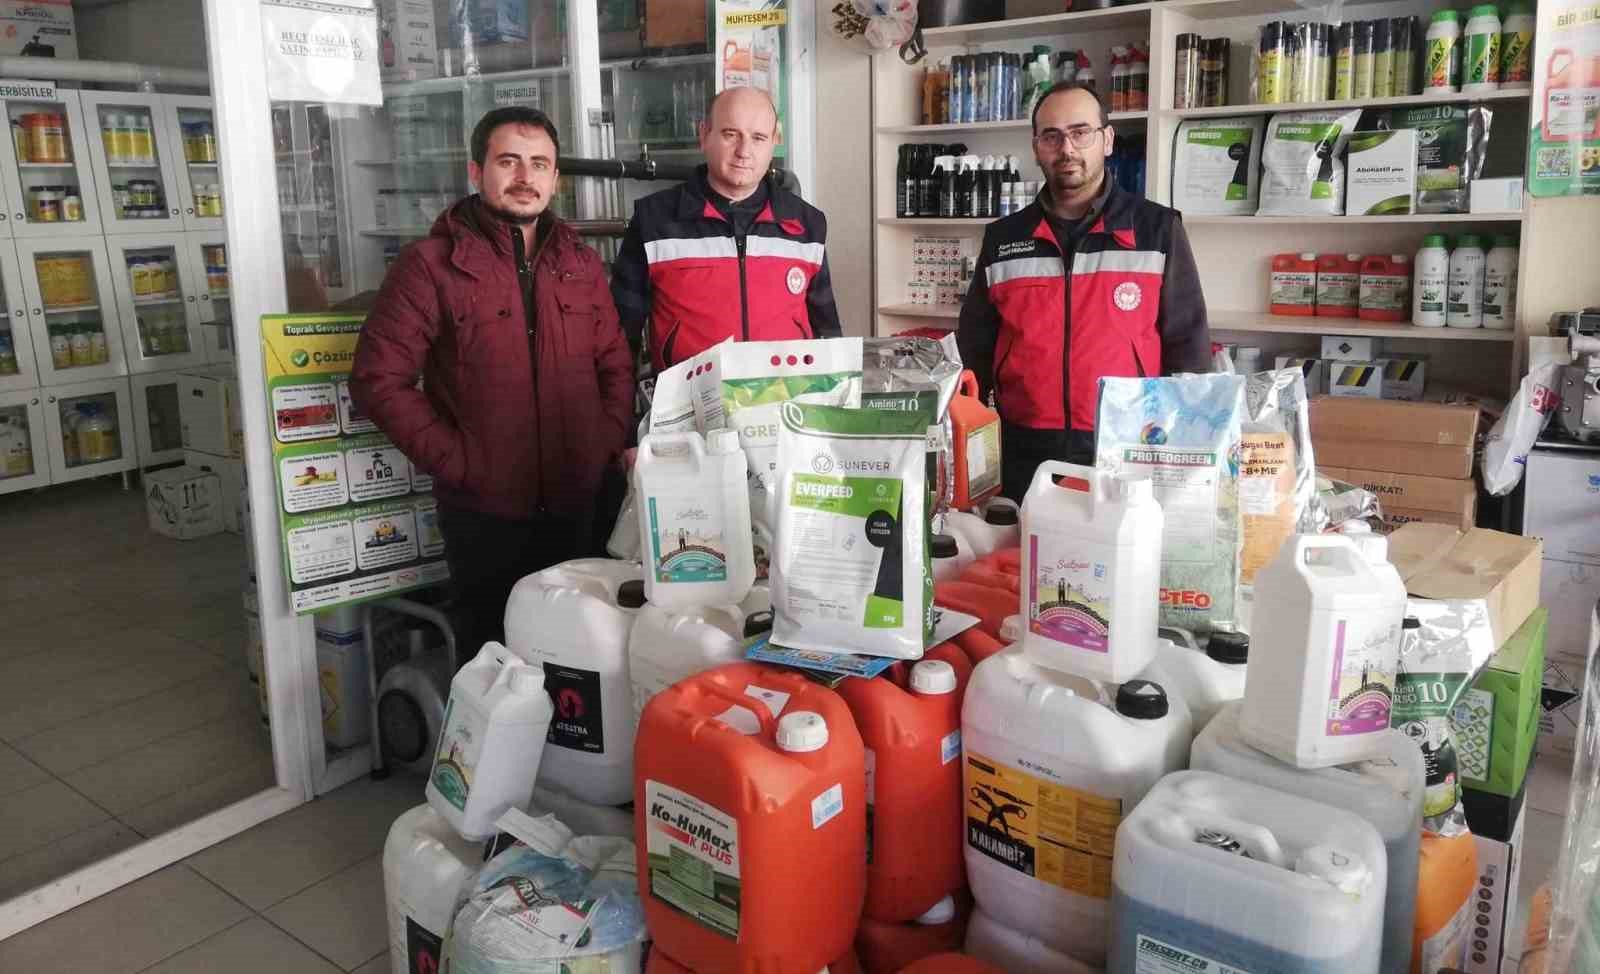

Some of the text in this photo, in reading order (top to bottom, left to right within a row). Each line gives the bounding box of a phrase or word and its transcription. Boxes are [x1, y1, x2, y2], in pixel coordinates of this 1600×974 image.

[868, 399, 897, 410] Amino
[744, 424, 779, 438] GRE
[838, 460, 890, 471] SUNEVER
[1129, 451, 1212, 465] PROTEOGREEN
[796, 481, 853, 498] EVERFEED
[1417, 682, 1448, 703] 10
[651, 803, 733, 852] Ko-HuMax
[700, 839, 734, 866] PLUS
